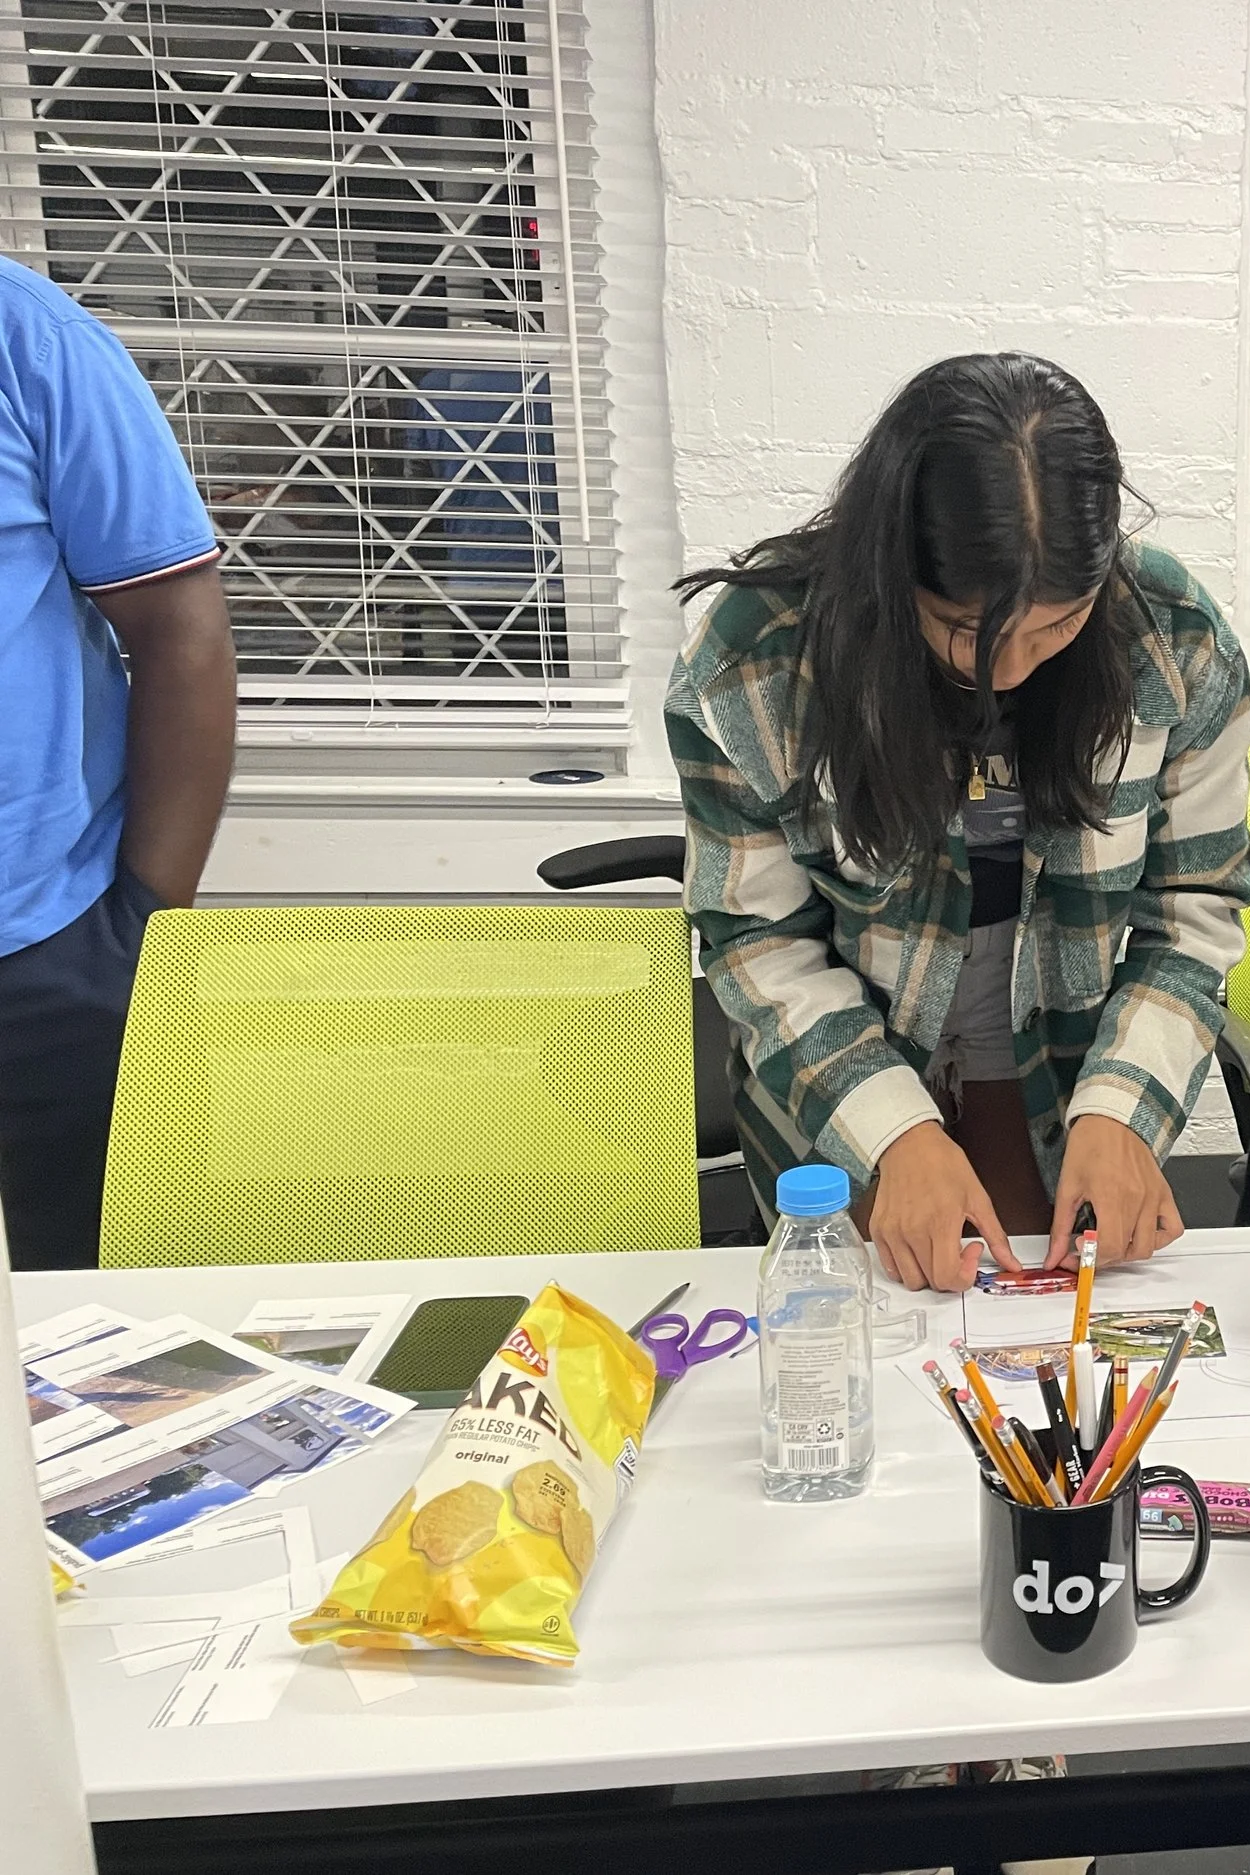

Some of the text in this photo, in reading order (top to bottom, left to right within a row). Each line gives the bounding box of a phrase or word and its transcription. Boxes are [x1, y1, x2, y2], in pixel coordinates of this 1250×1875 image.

[449, 1372, 582, 1463] AKED
[451, 1418, 541, 1444] 65% LESS FAT
[489, 1435, 515, 1448] POTATO
[455, 1450, 510, 1465] original
[1065, 1459, 1080, 1483] GEAR
